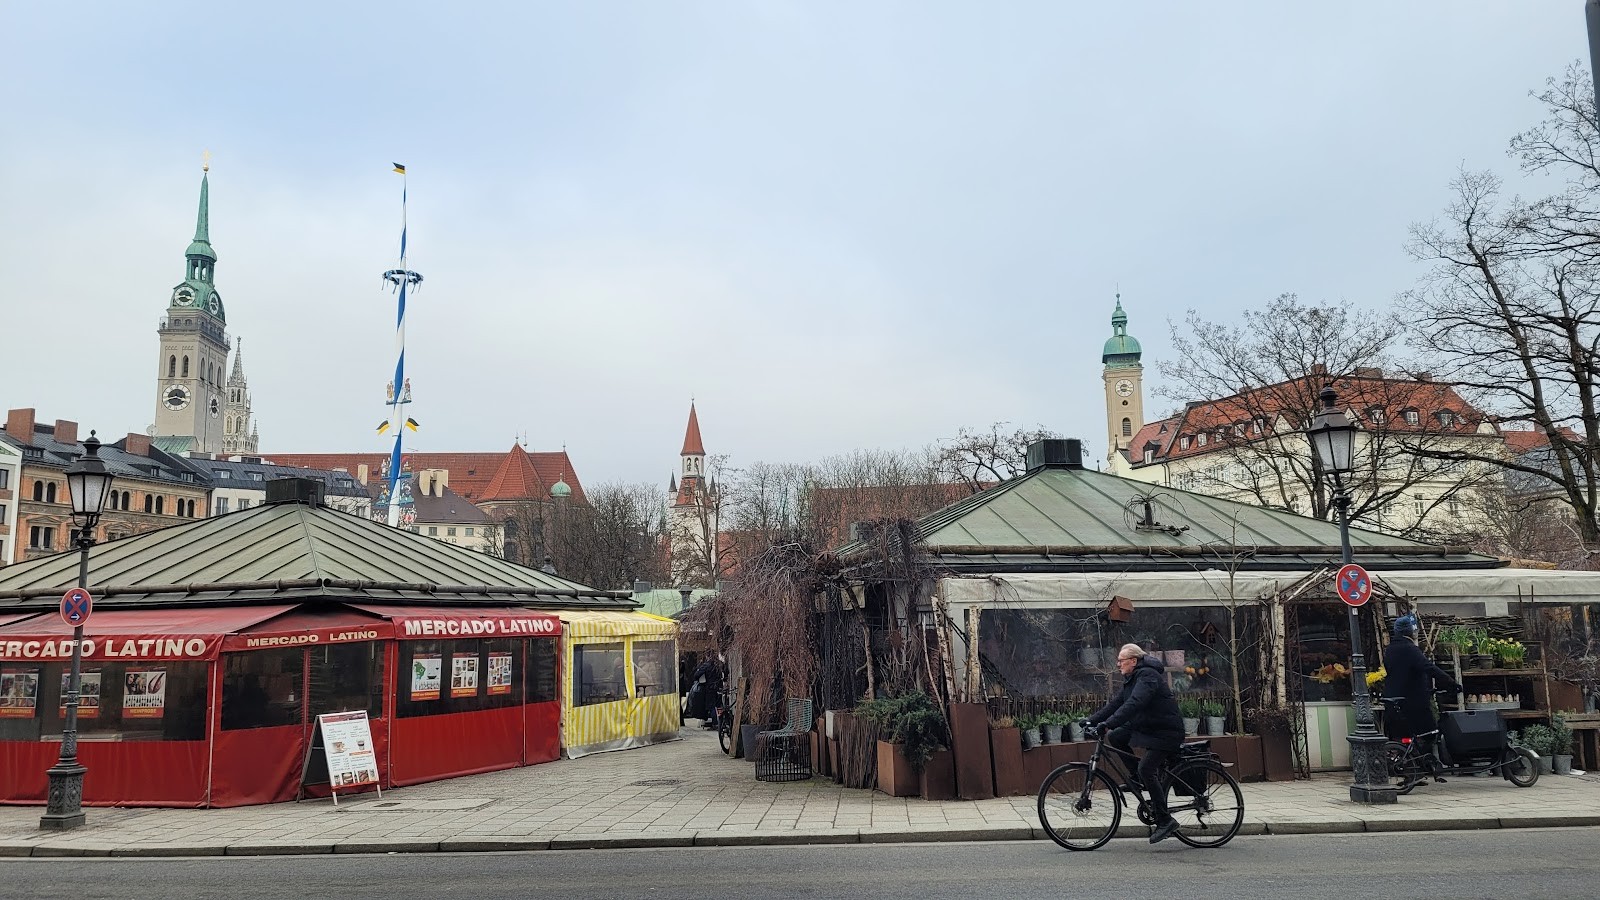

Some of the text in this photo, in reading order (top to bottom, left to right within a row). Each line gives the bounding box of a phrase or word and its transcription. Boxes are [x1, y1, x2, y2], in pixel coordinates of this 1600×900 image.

[404, 618, 554, 636] MERCADO LATINO
[104, 638, 207, 657] LATINO
[247, 630, 378, 647] MERCADO LATINO
